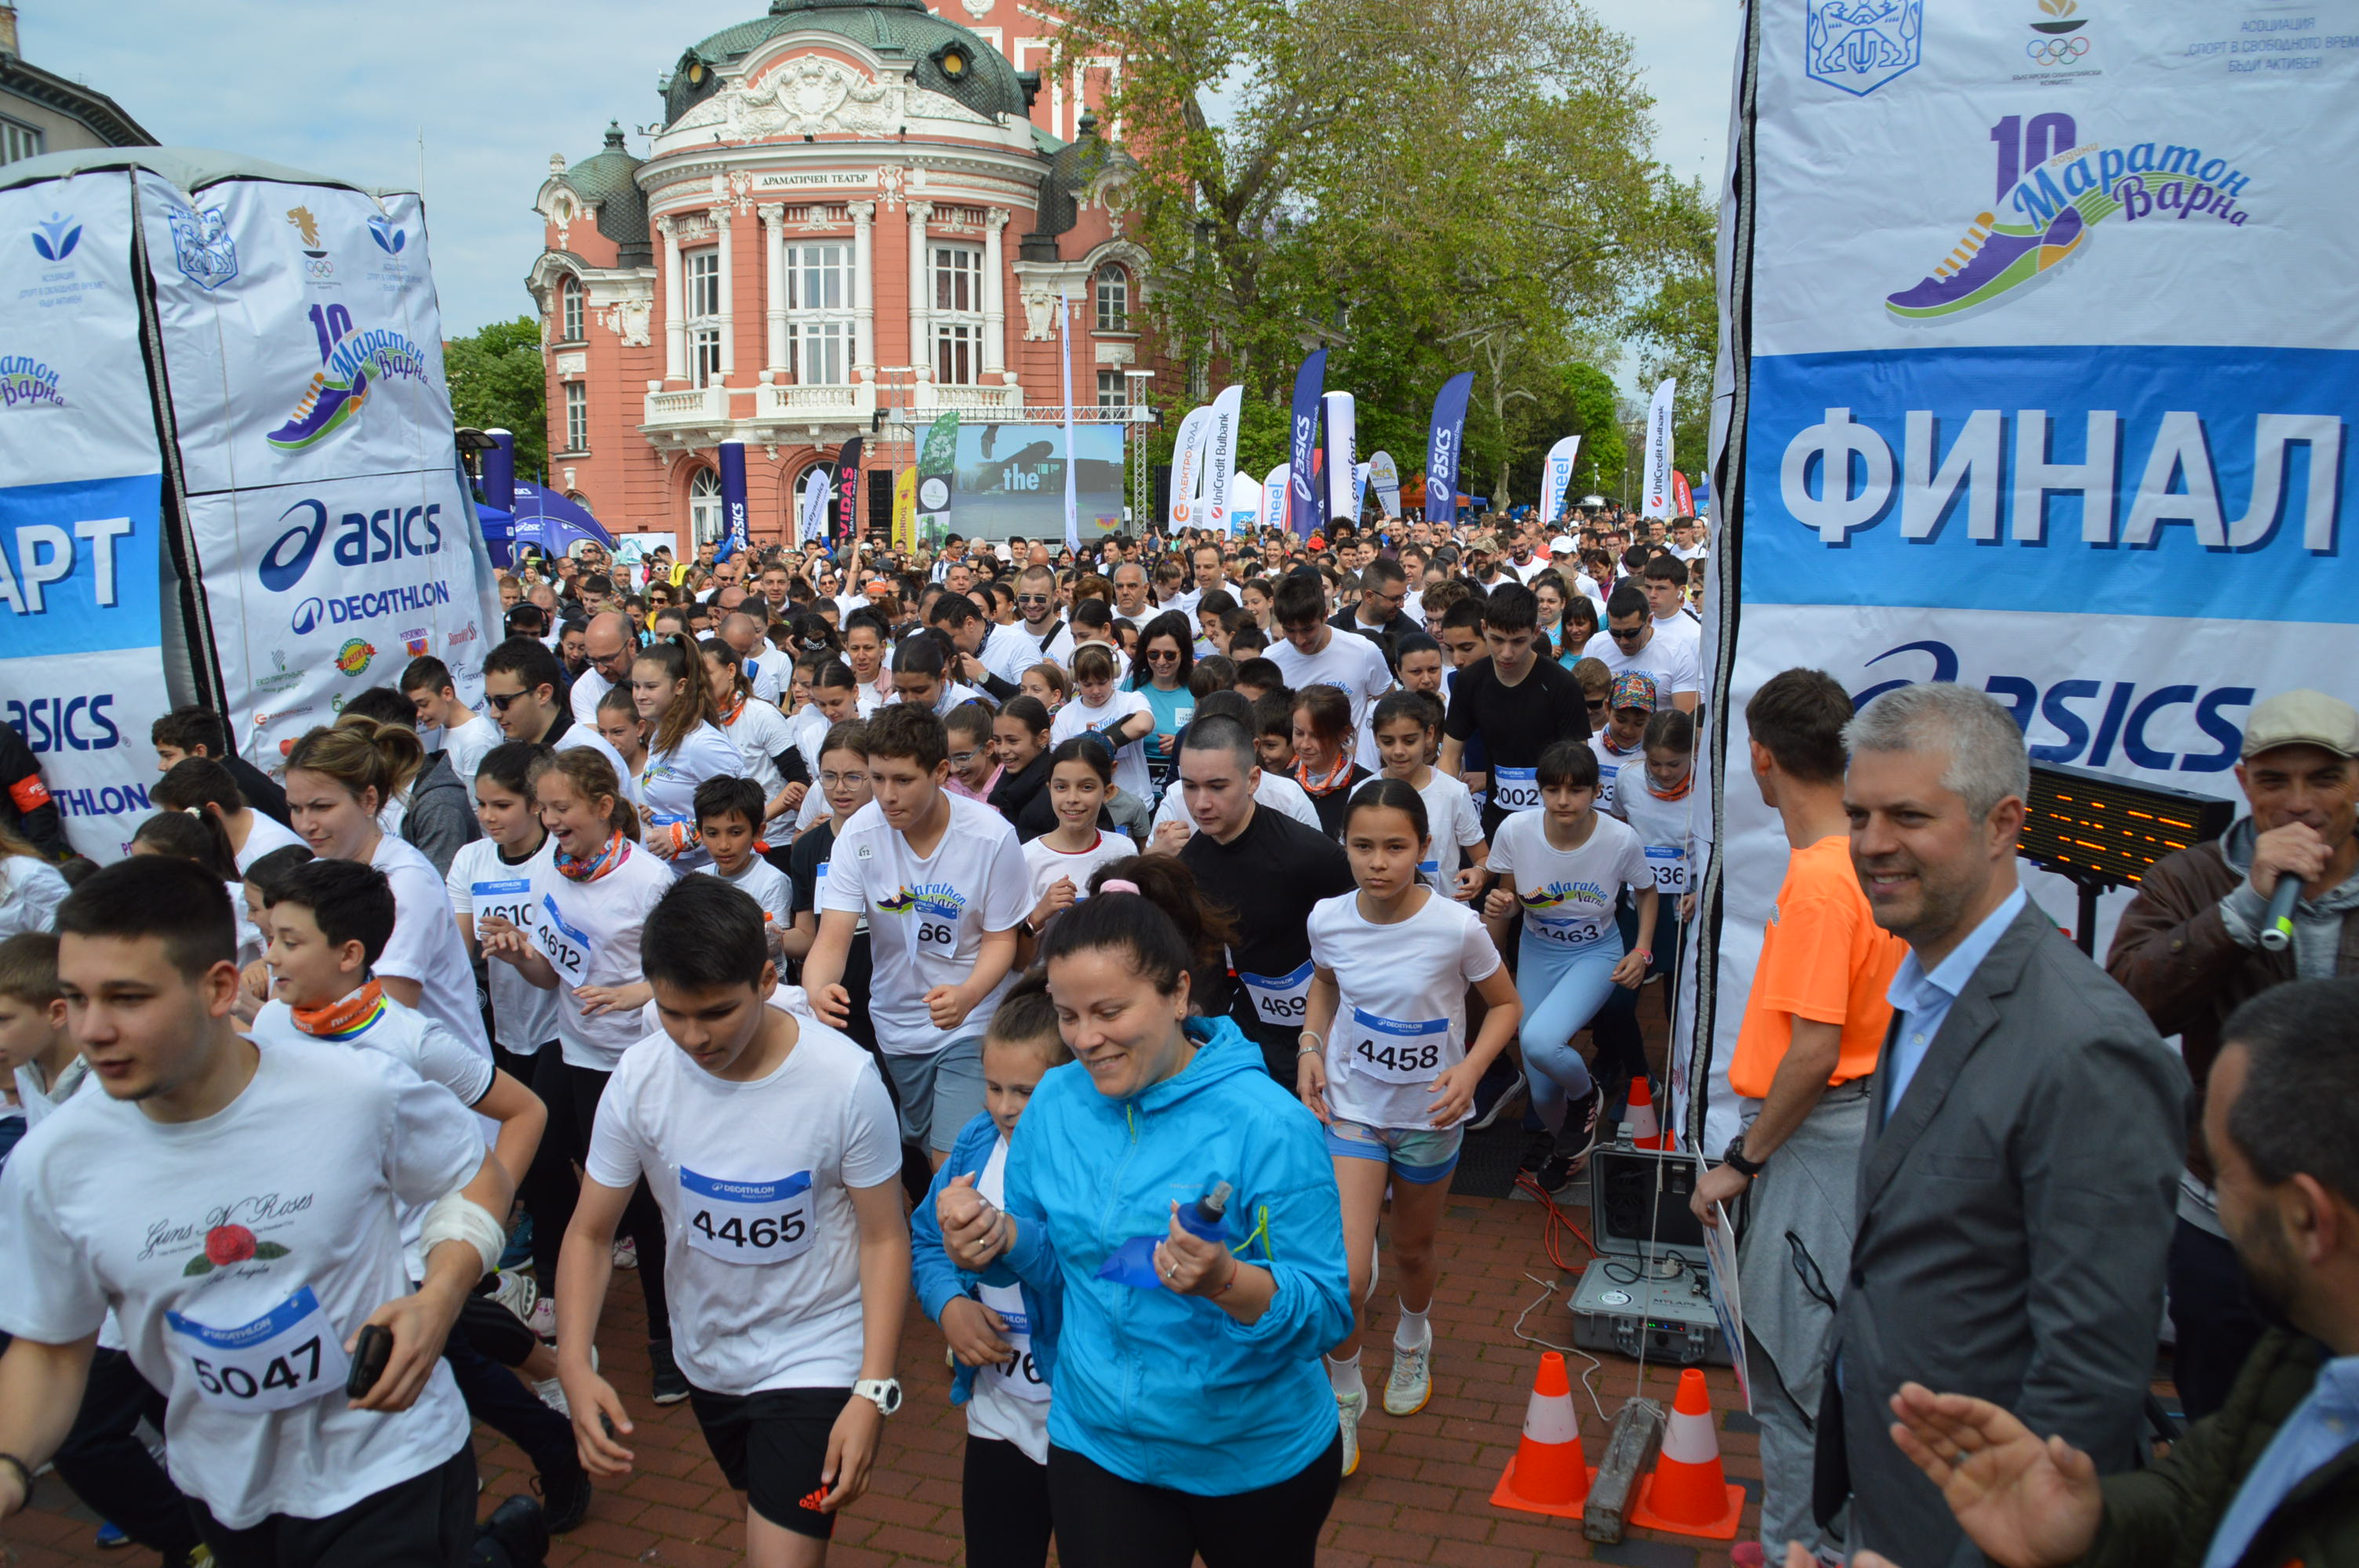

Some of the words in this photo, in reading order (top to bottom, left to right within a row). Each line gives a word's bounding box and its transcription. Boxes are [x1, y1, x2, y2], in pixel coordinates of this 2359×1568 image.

[2241, 17, 2315, 32] АСОЦИАЦИЯ
[2231, 42, 2239, 53] В
[2242, 37, 2321, 53] СВОБОДНОТО
[2228, 60, 2261, 72] БЪДИ
[1990, 112, 2077, 207] 10
[761, 174, 828, 187] ДРАМАТИЧЕН
[831, 173, 868, 184] ТЕАТЪР
[2013, 142, 2252, 231] Маратон
[2112, 175, 2251, 227] Варна
[308, 303, 354, 368] 10
[332, 328, 425, 386] Маратон
[376, 350, 428, 385] Варна
[0, 377, 64, 407] Варна
[1216, 412, 1229, 456] Bulbank
[1002, 463, 1039, 491] the
[1213, 458, 1225, 506] UniCredit
[1652, 448, 1663, 495] UniCredit
[1779, 407, 2345, 555] ФИНАЛ
[804, 481, 824, 539] MaxDynamics
[329, 581, 450, 624] DECATHLON
[400, 627, 429, 641] PERSKINDOL
[51, 783, 152, 817] THLON
[910, 882, 966, 906] arathon
[1547, 880, 1608, 902] Marathon
[1574, 891, 1605, 908] Varna
[539, 924, 581, 974] 4612
[918, 922, 951, 944] 66
[1358, 1040, 1439, 1072] 4458
[725, 1185, 775, 1195] DECATHLON
[137, 1218, 194, 1261] Guns
[246, 1192, 314, 1224] Roses
[692, 1208, 805, 1248] 4465
[1654, 1298, 1697, 1307] MYLAPS
[192, 1334, 321, 1399] 5047
[996, 1349, 1043, 1385] 76
